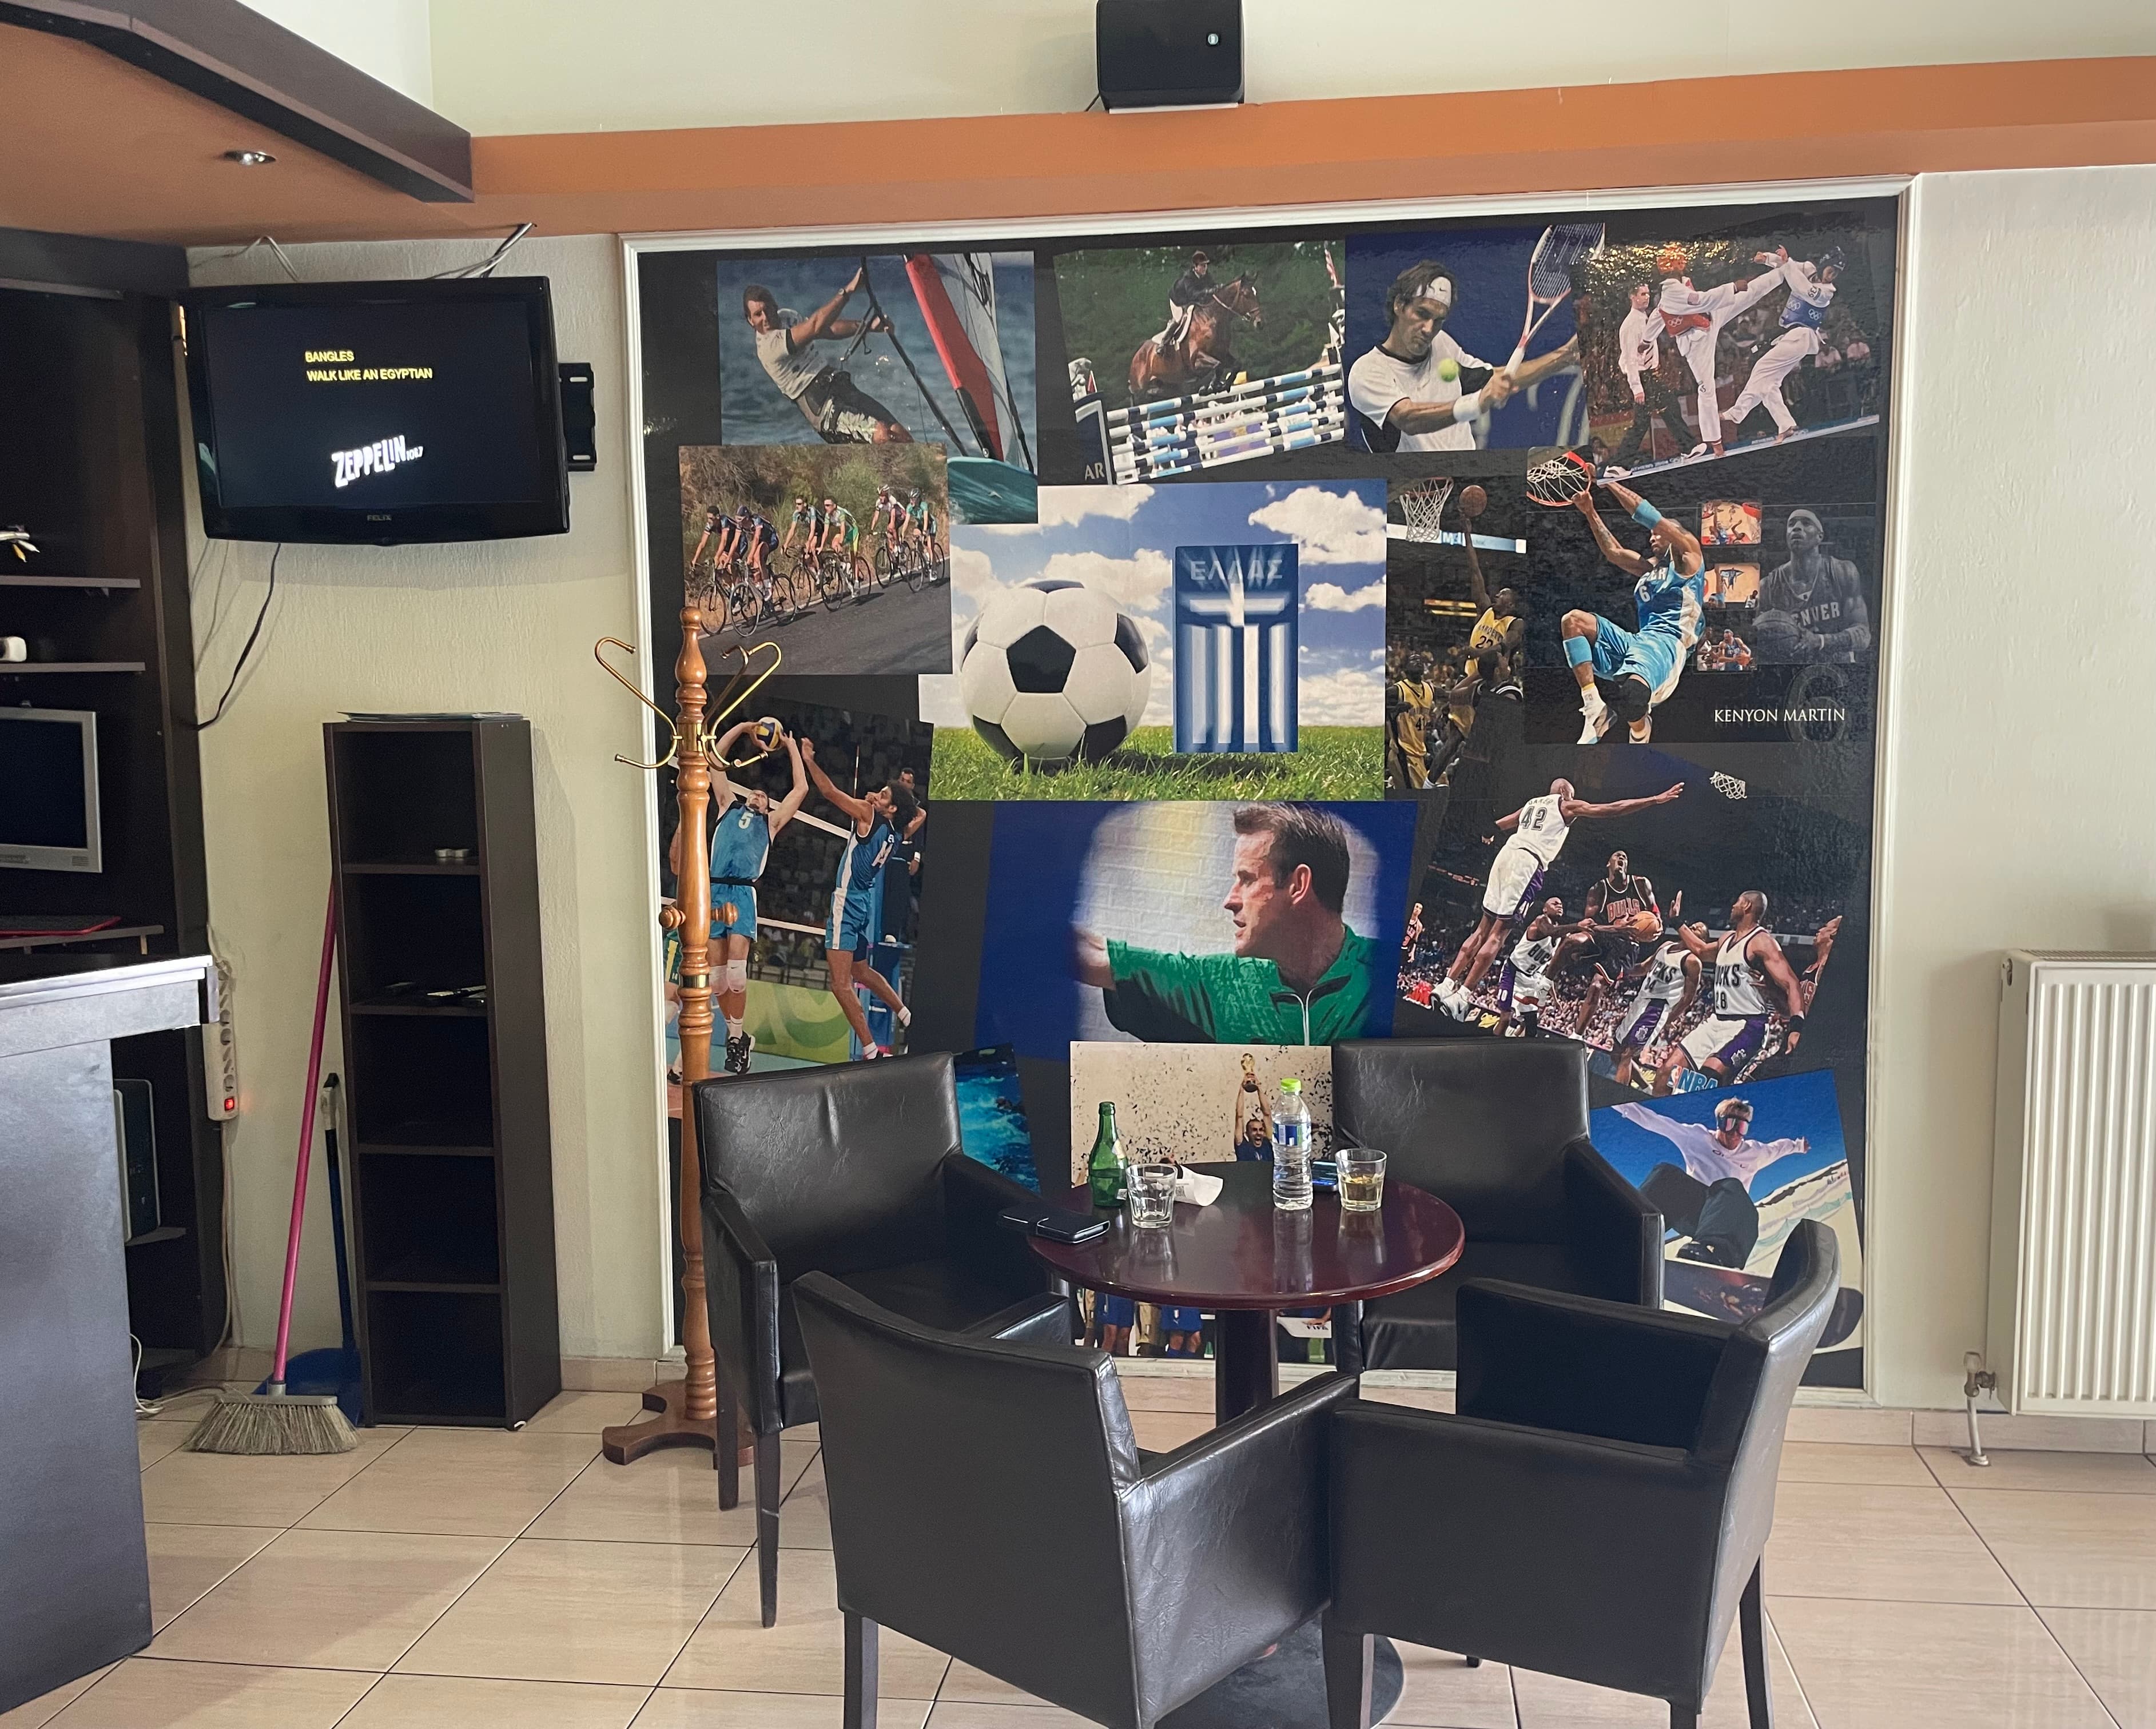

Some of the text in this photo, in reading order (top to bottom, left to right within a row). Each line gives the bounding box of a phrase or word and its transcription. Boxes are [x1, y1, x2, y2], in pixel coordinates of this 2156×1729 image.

[305, 350, 355, 362] BANGLES
[307, 368, 433, 381] WALK LIKE AN EGYPTIAN
[331, 435, 406, 488] ZEPPELIN
[1638, 585, 1651, 602] 6
[1791, 601, 1840, 627] ENVER
[1714, 708, 1845, 722] KENYON MARTIN
[738, 812, 754, 829] 5
[1520, 806, 1548, 831] 42
[1677, 1067, 1719, 1093] NBA
